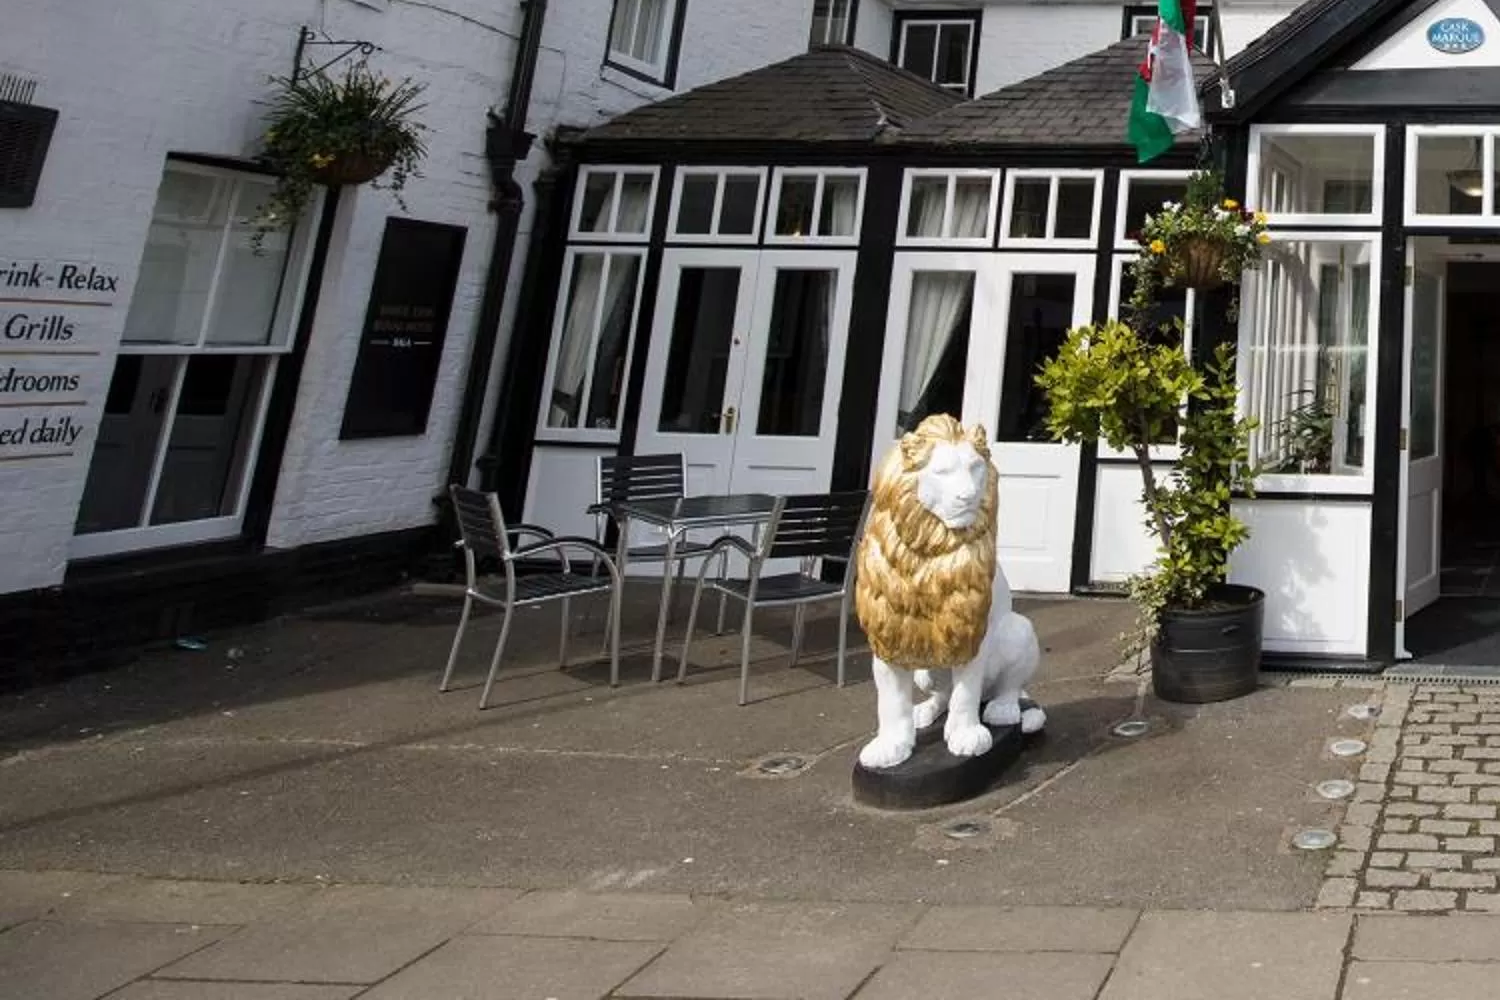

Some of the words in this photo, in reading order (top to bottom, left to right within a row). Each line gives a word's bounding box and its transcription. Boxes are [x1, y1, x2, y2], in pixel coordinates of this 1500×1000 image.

[1440, 22, 1469, 33] CASK
[58, 265, 119, 293] Relax
[4, 312, 75, 341] Grills
[29, 415, 83, 446] daily
